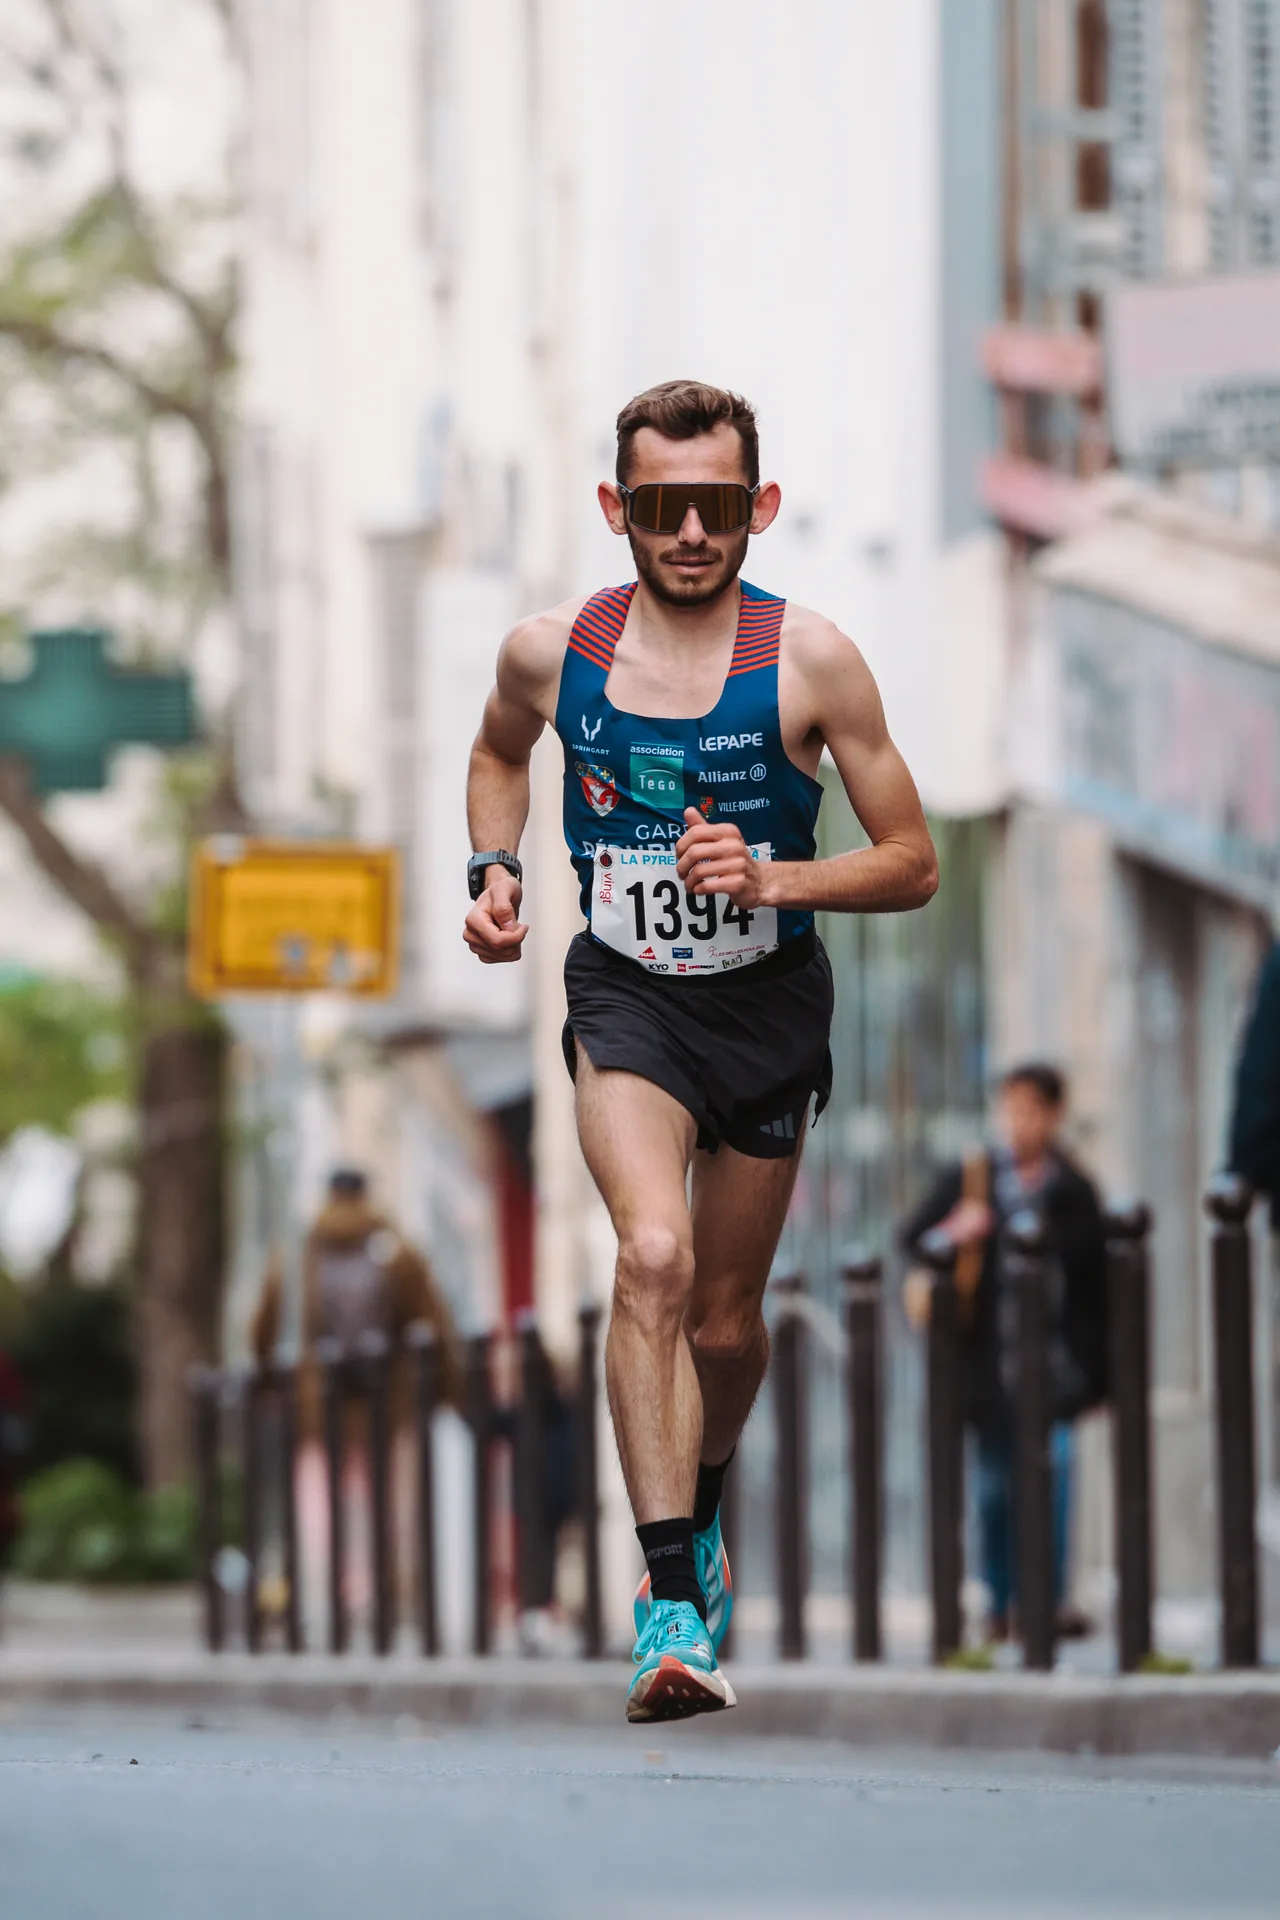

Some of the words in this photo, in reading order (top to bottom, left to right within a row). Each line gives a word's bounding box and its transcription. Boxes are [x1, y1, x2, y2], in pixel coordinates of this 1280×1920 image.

[699, 732, 763, 751] LEPAPE
[571, 742, 610, 756] SPRINGART
[630, 745, 685, 758] association
[697, 770, 748, 783] Allianz
[620, 853, 638, 865] LA
[599, 872, 615, 905] vingt
[626, 879, 755, 941] 1394
[649, 963, 669, 971] KYO
